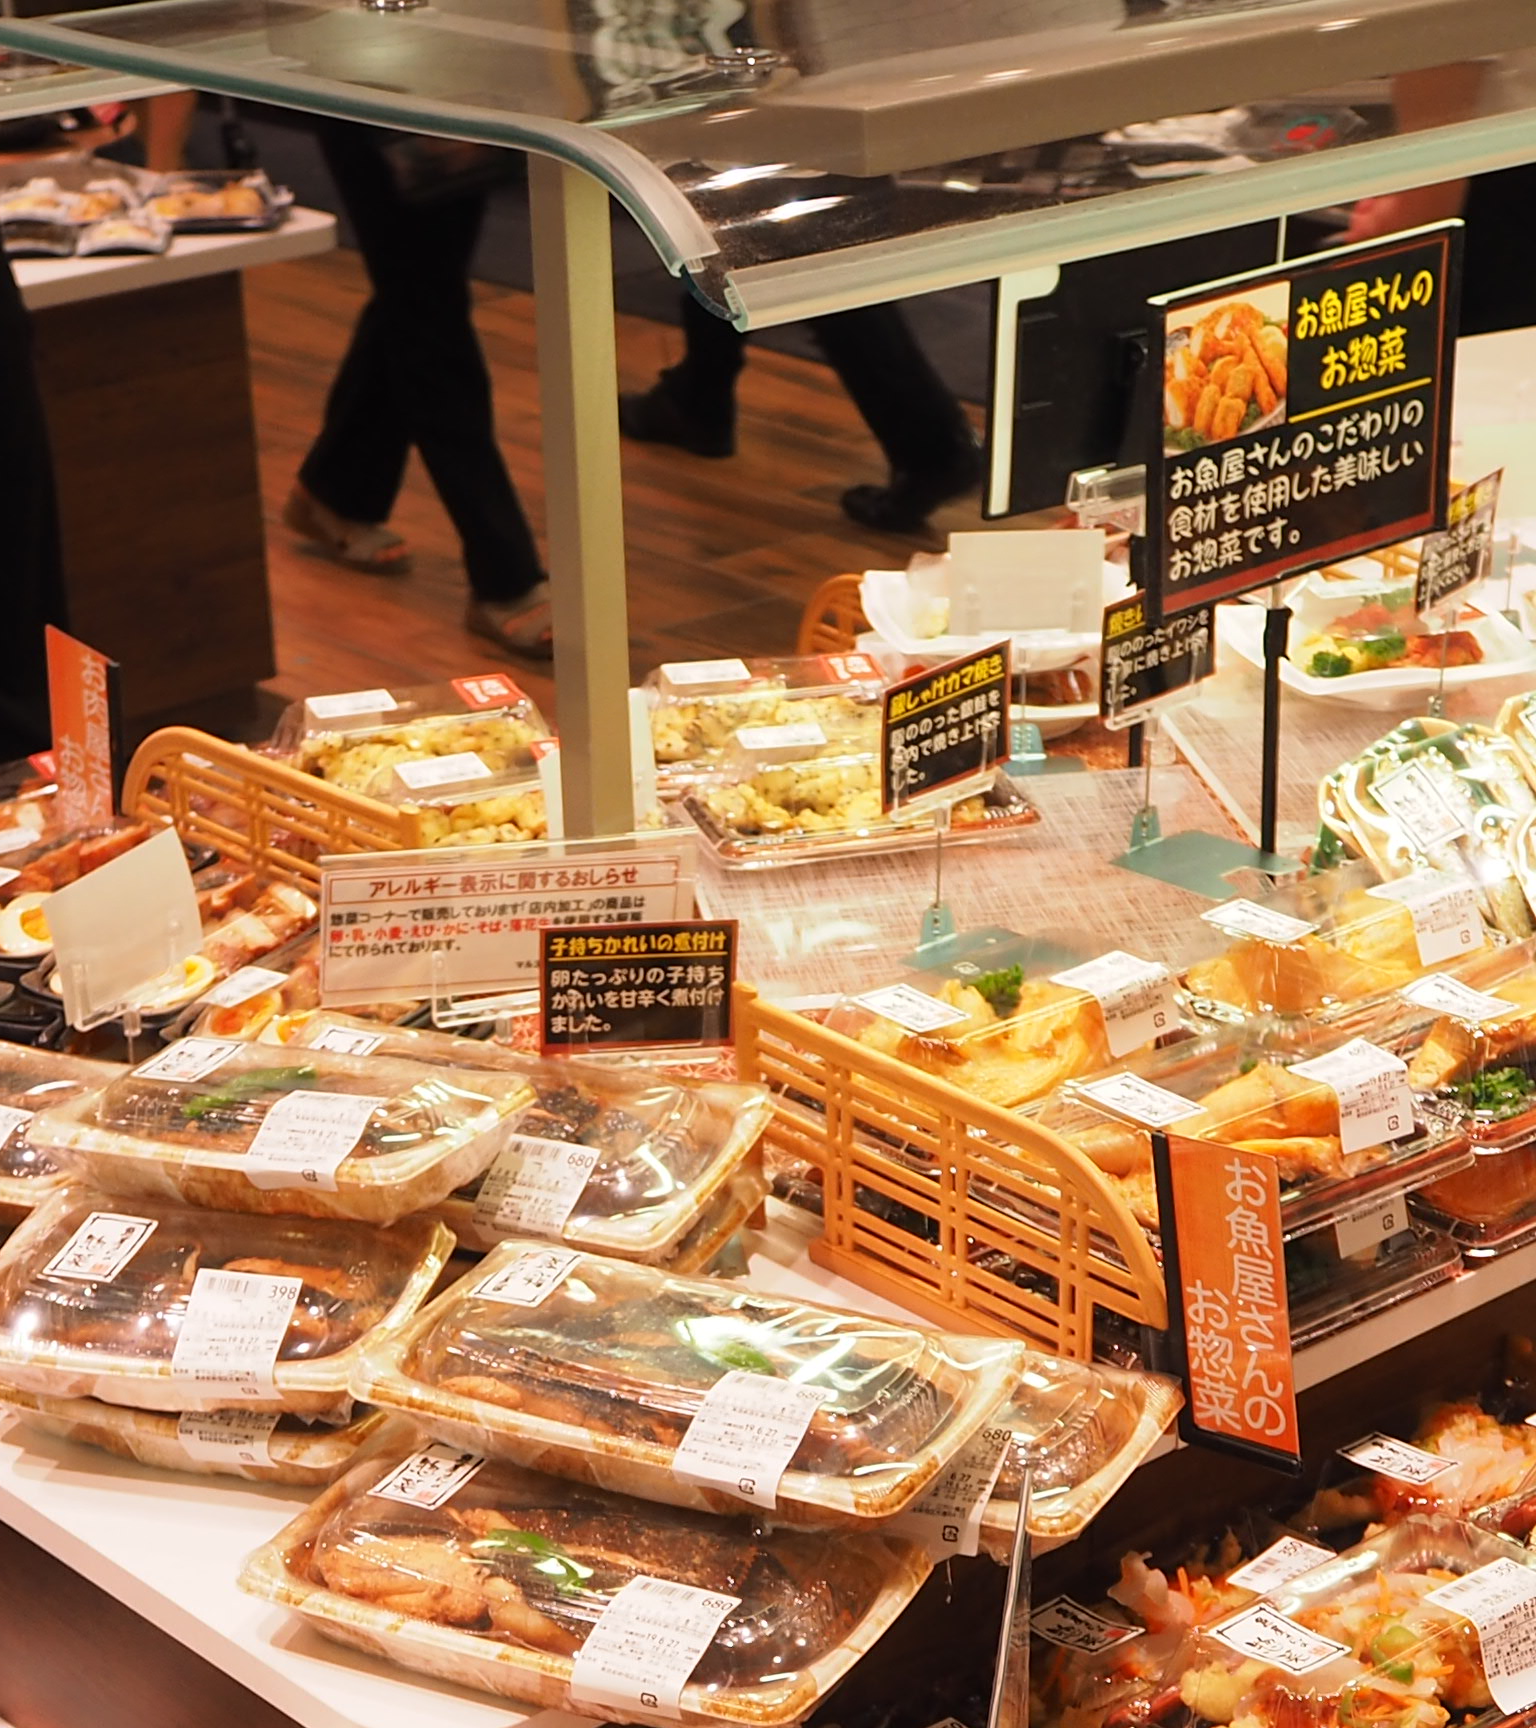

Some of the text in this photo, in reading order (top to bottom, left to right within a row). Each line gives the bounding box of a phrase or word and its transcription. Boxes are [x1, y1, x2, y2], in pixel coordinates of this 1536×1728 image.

[1296, 269, 1433, 339] お魚屋さんの
[1321, 326, 1407, 390] お惣菜
[1170, 399, 1424, 499] お魚屋さんのこだわりの
[1168, 440, 1424, 542] 食材を使用した美味しい
[1169, 517, 1302, 580] お惣菜です。
[369, 867, 639, 898] アレルギー表示に関するおしらせ
[550, 931, 727, 958] 子持ちかれいの煮付け
[551, 965, 725, 988] 卵たっぷりの子持ち
[552, 987, 725, 1011] かれいを甘辛く煮付け
[551, 1014, 612, 1034] ました。
[566, 1152, 596, 1170] 680
[267, 1285, 298, 1300] 398
[1222, 1156, 1287, 1437] お魚屋さんの
[1185, 1279, 1242, 1431] お惣菜
[982, 1428, 1013, 1443] 680
[701, 1597, 734, 1612] 680
